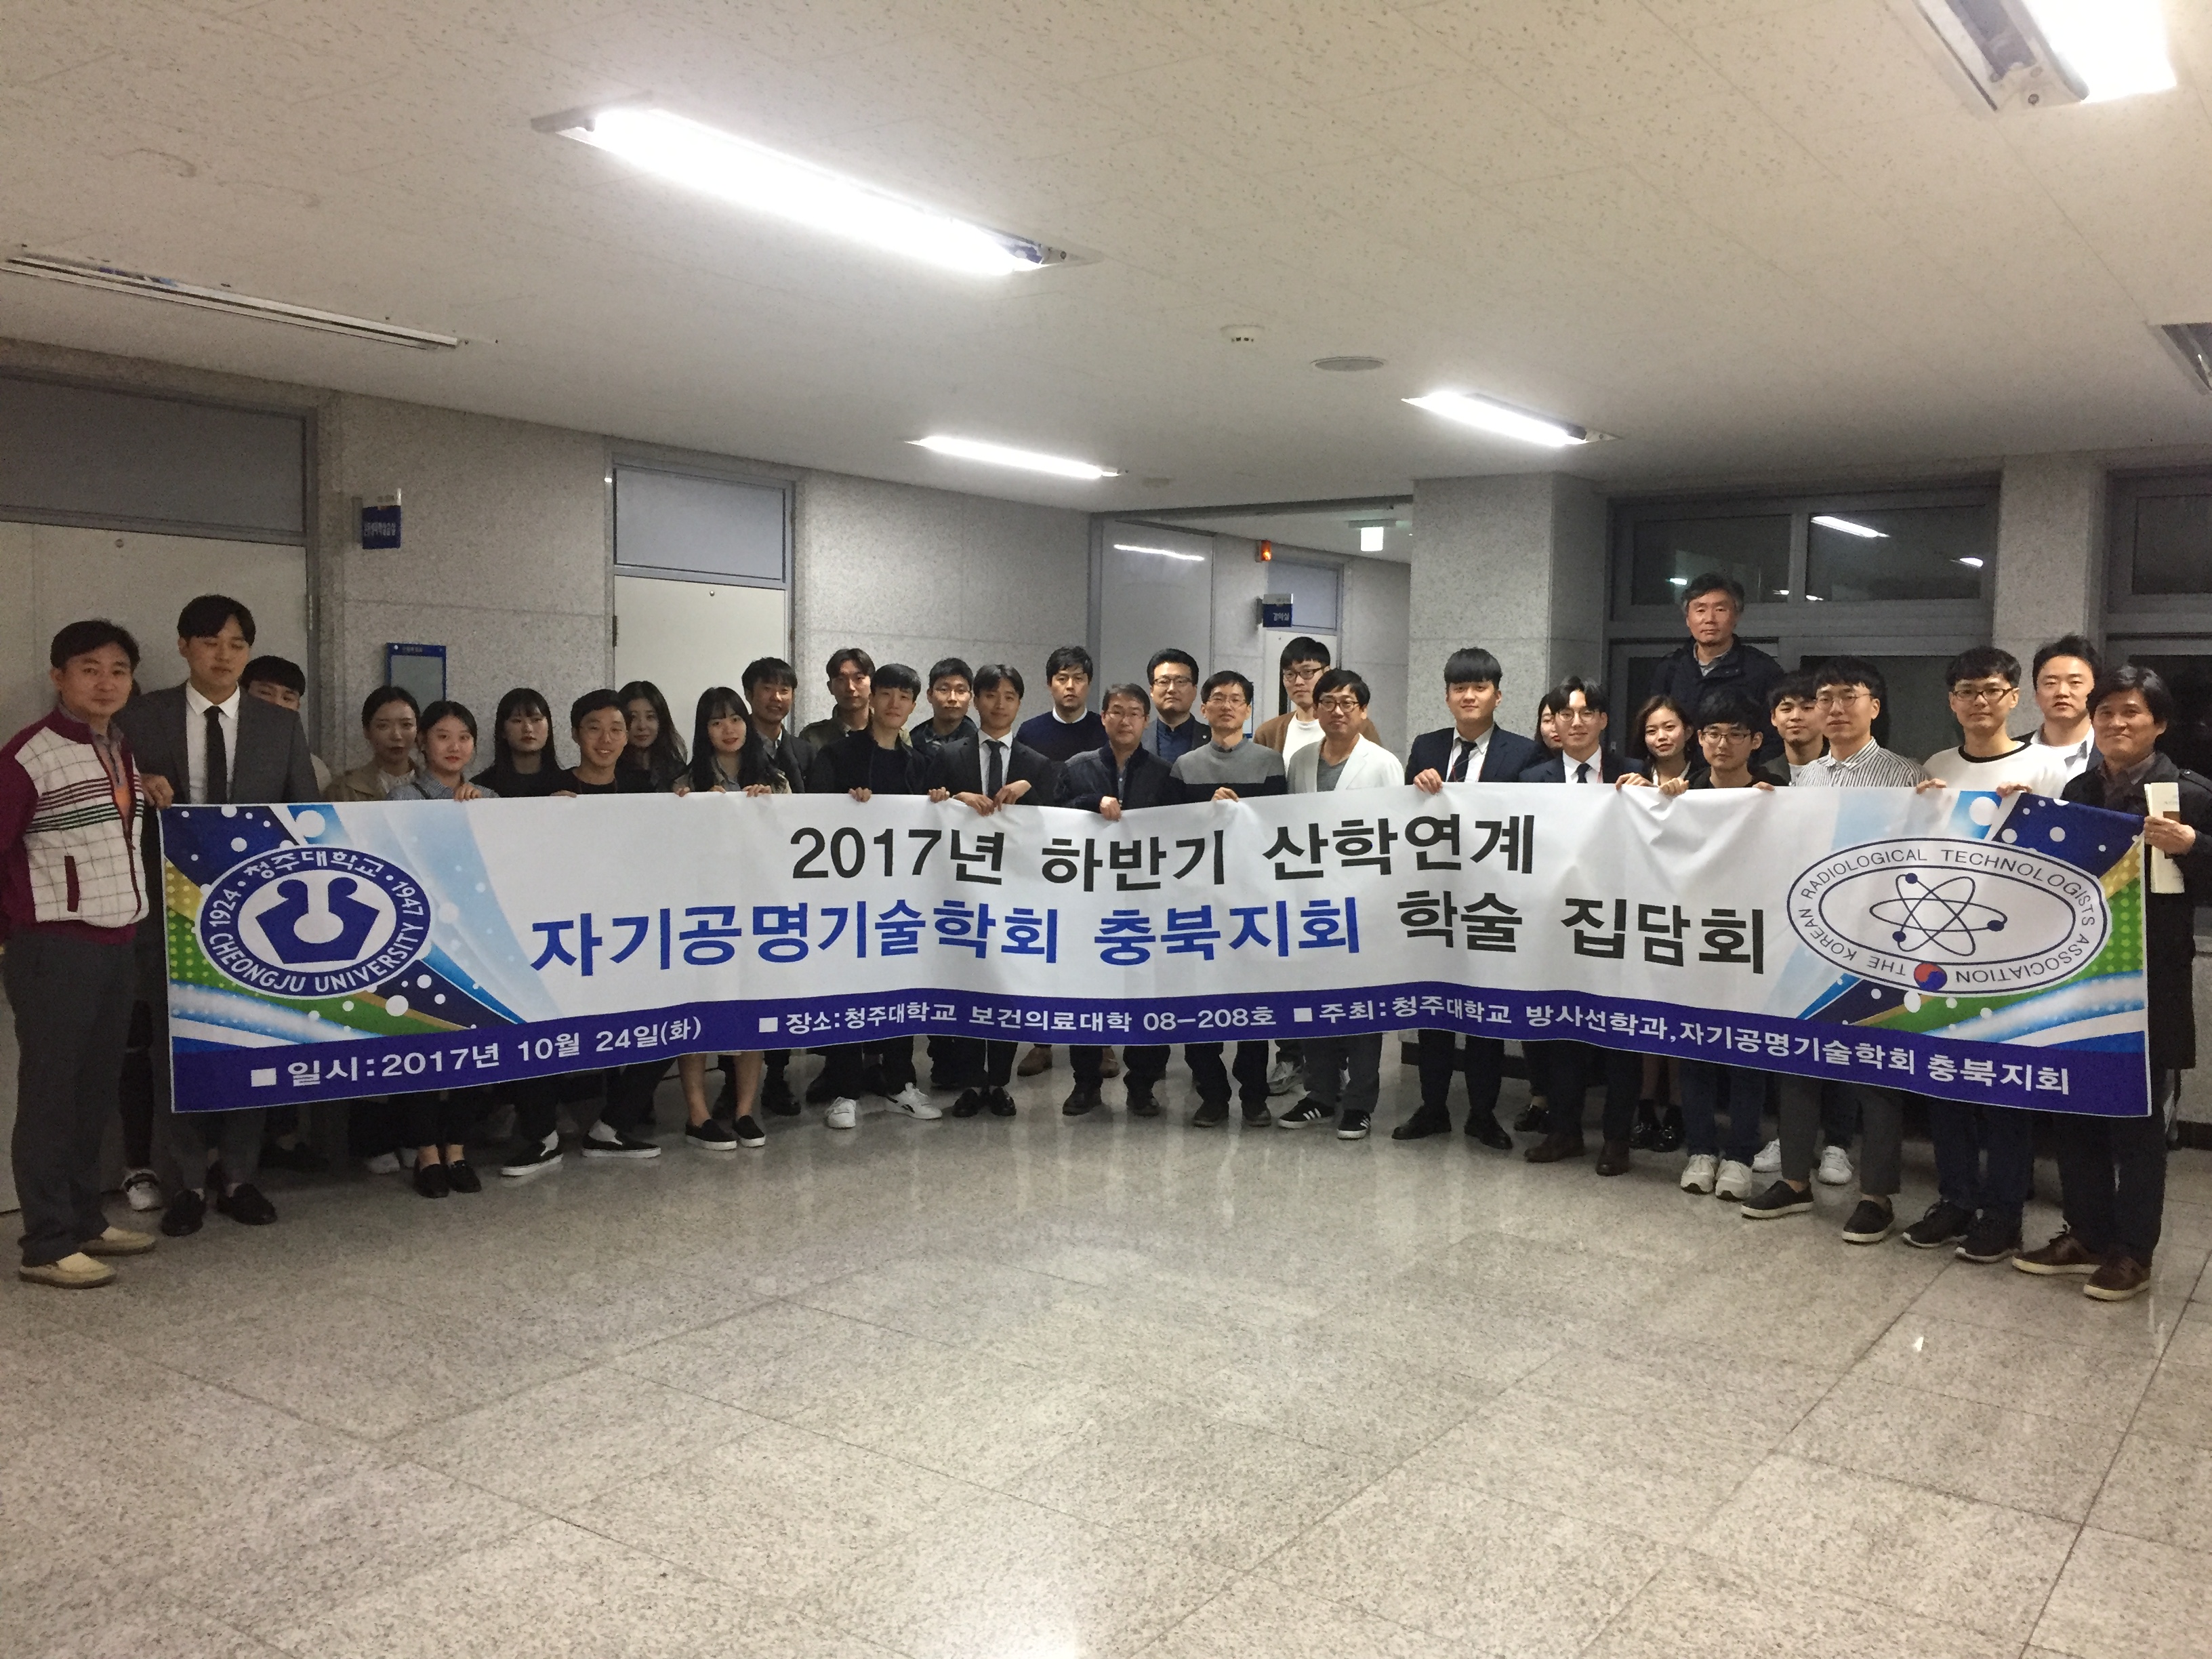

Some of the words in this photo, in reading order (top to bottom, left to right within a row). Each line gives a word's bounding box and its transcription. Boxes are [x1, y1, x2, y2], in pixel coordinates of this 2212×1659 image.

[243, 851, 384, 878] 청주대학교
[790, 827, 1004, 884] 2017년
[1042, 830, 1224, 893] 하반기
[1263, 813, 1534, 880] 산학연계
[1801, 848, 1927, 899] RADIOLOGICAL
[209, 888, 241, 927] 1924
[391, 881, 424, 915] 1947
[1941, 848, 2095, 926] TECHNOLOGISTS
[209, 933, 306, 992] CHEONGJU
[314, 922, 424, 992] UNIVERSITY
[531, 899, 1057, 976] 자기공명기술학회
[1094, 897, 1359, 966] 충북지회
[1397, 890, 1522, 952] 학술
[1561, 898, 1764, 973] 집담회
[1799, 909, 1857, 961] KOREAN
[1955, 933, 2089, 983] ASSOCIATION
[1867, 956, 1906, 976] THE
[786, 1002, 956, 1033] 장소:청주대학교
[969, 1005, 1132, 1032] 보건의료대학
[1143, 1006, 1276, 1033] 08-208호
[287, 1042, 500, 1087] 일시:2017년
[518, 1032, 580, 1061] 10월
[596, 1016, 701, 1052] 24일(화)
[1319, 996, 1512, 1024] 주최:청주대학교
[1927, 1054, 2069, 1094] 충북지회
